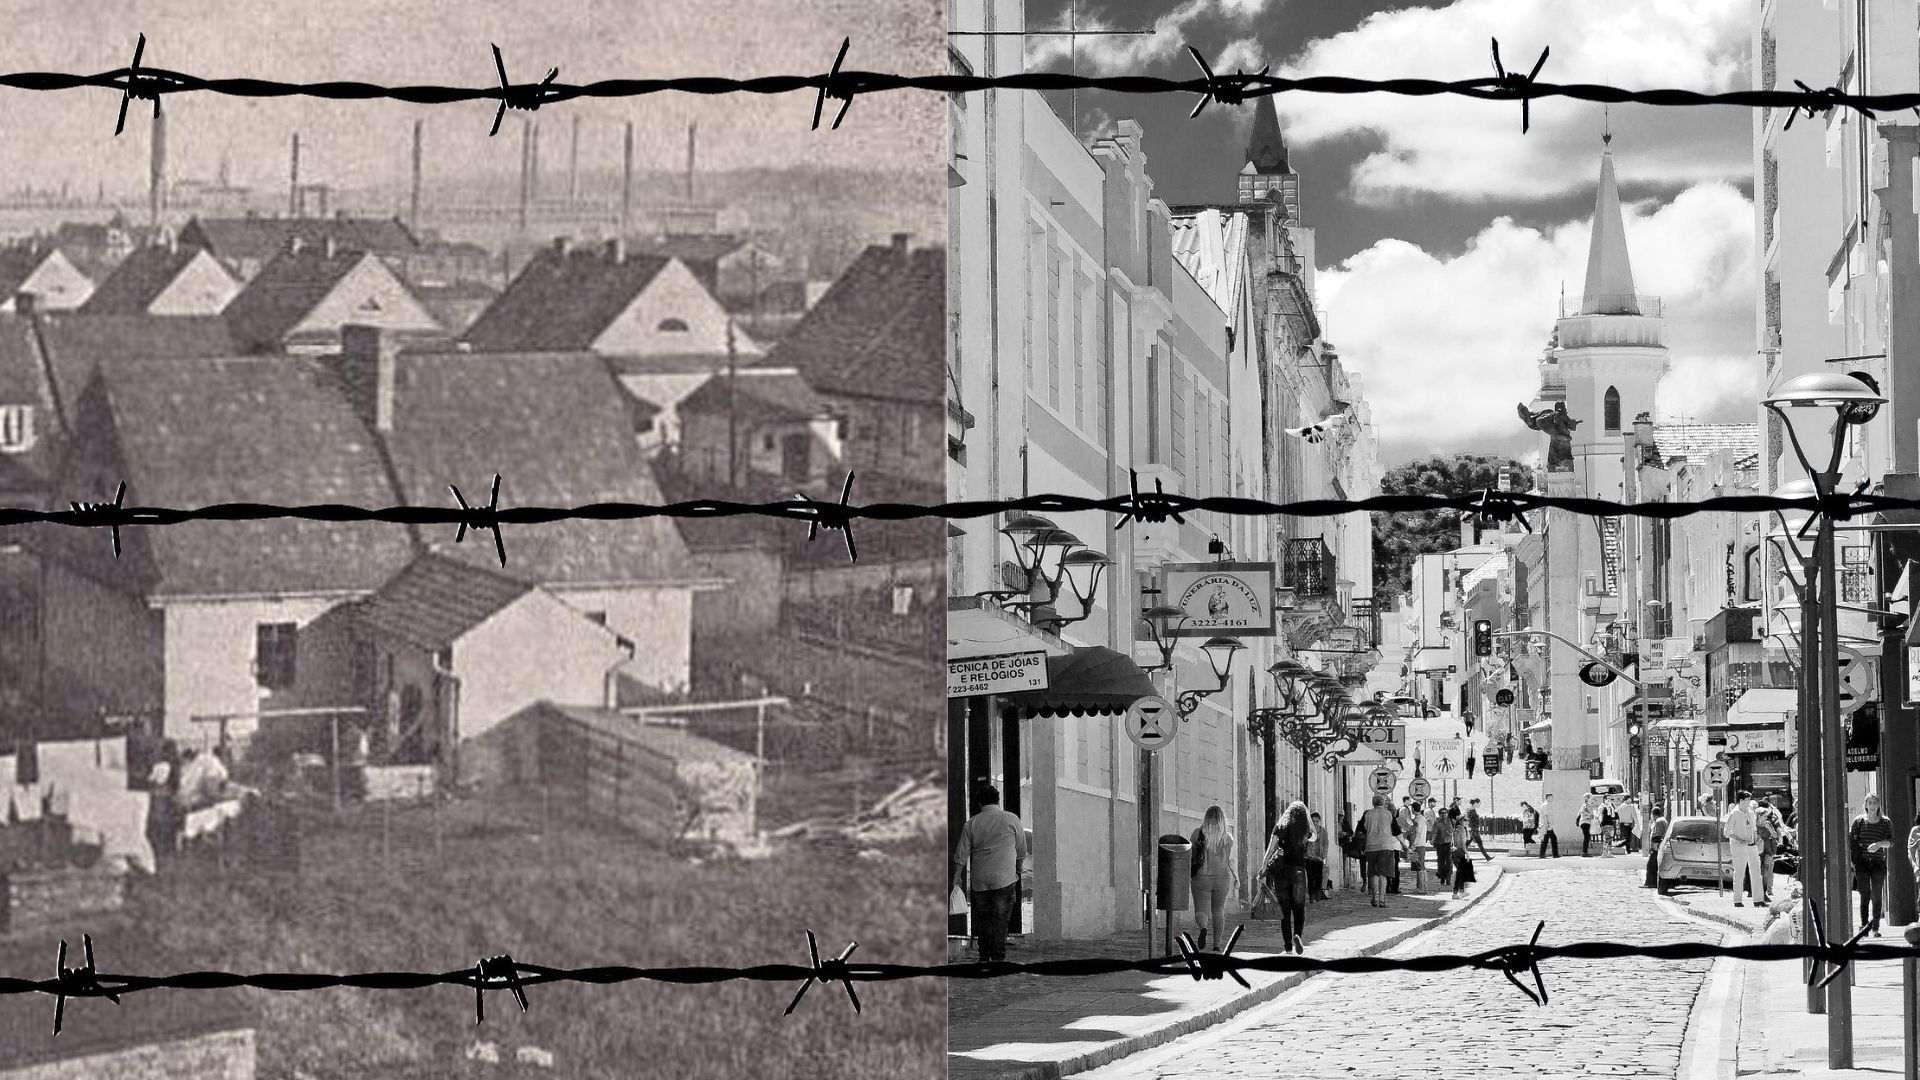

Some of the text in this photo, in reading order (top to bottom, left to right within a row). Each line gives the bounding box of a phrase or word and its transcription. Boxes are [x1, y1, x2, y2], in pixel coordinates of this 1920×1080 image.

[1231, 580, 1245, 592] DA
[1245, 591, 1258, 613] LUZ
[1190, 619, 1248, 627] 3222-4161
[948, 656, 1040, 674] ÉCNICA DE JÓIAS
[960, 669, 1025, 683] E RELÓGIOS
[1028, 678, 1041, 686] 131
[952, 683, 989, 694] 223-6462
[1346, 727, 1399, 743] SKOL
